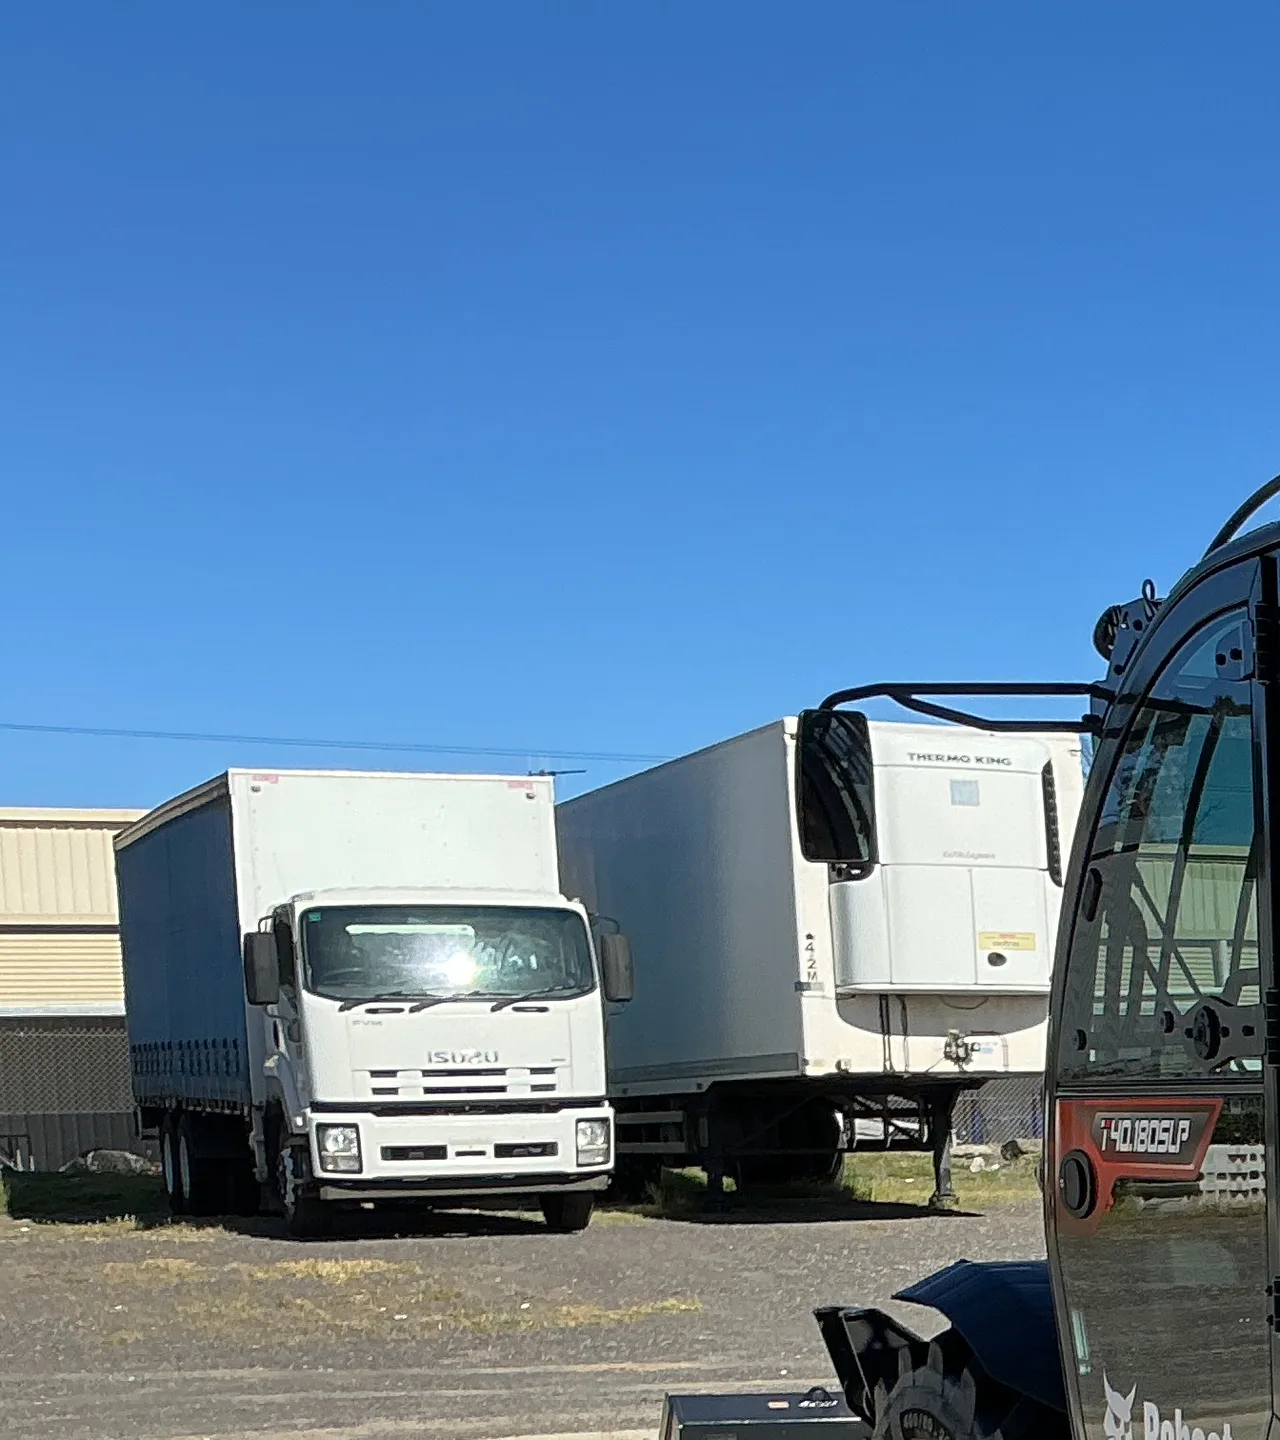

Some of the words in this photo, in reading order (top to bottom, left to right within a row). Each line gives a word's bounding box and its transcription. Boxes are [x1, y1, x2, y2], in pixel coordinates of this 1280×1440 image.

[907, 752, 971, 764] THERMO
[974, 756, 1013, 766] KING
[427, 1050, 499, 1064] ISUZU
